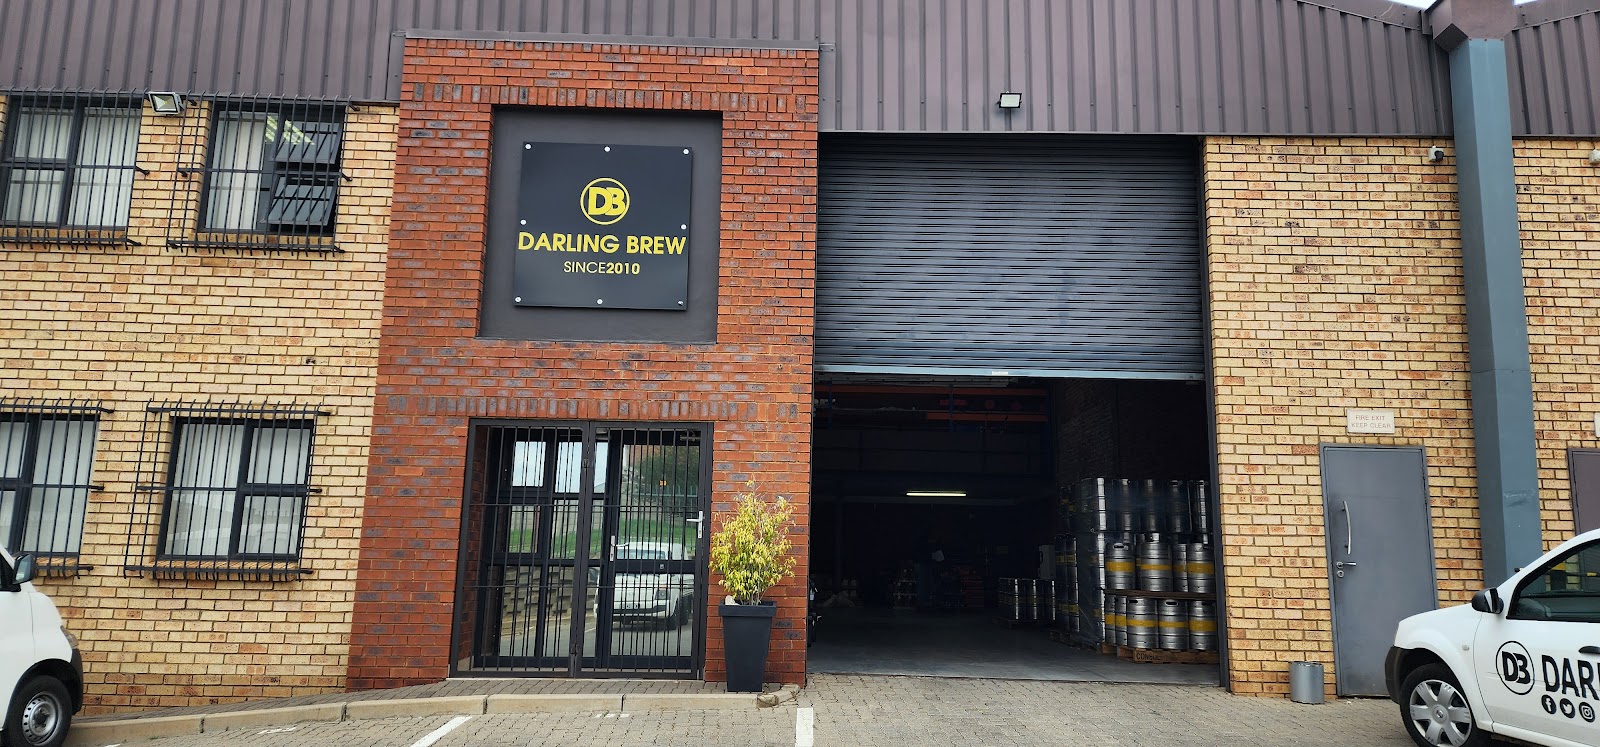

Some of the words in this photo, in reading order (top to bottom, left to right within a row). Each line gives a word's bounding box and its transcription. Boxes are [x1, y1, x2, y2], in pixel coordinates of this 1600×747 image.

[587, 186, 627, 216] DB
[518, 231, 620, 254] DARLING
[626, 235, 687, 255] BREW
[563, 260, 641, 275] SINCE2010
[1501, 650, 1531, 685] DB
[1541, 654, 1600, 701] DAR
